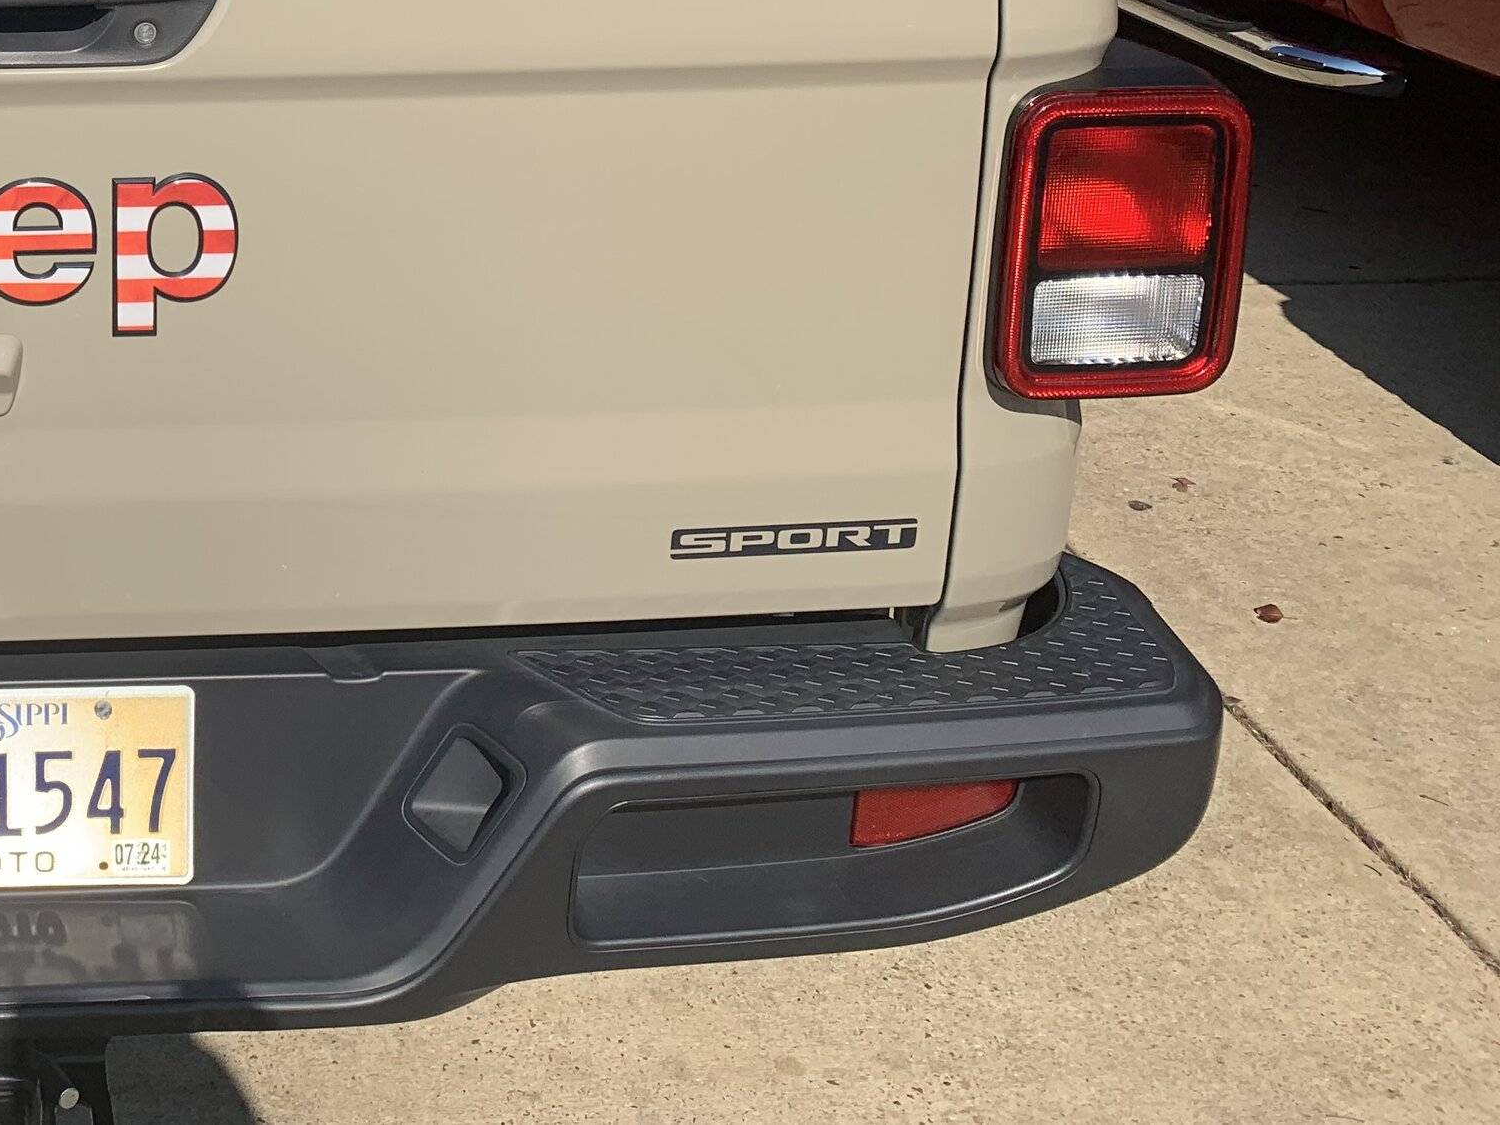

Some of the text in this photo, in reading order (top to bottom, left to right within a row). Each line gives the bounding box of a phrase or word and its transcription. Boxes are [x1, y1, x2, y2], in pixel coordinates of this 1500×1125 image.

[669, 522, 918, 555] SPORT
[115, 842, 160, 865] 07 24
